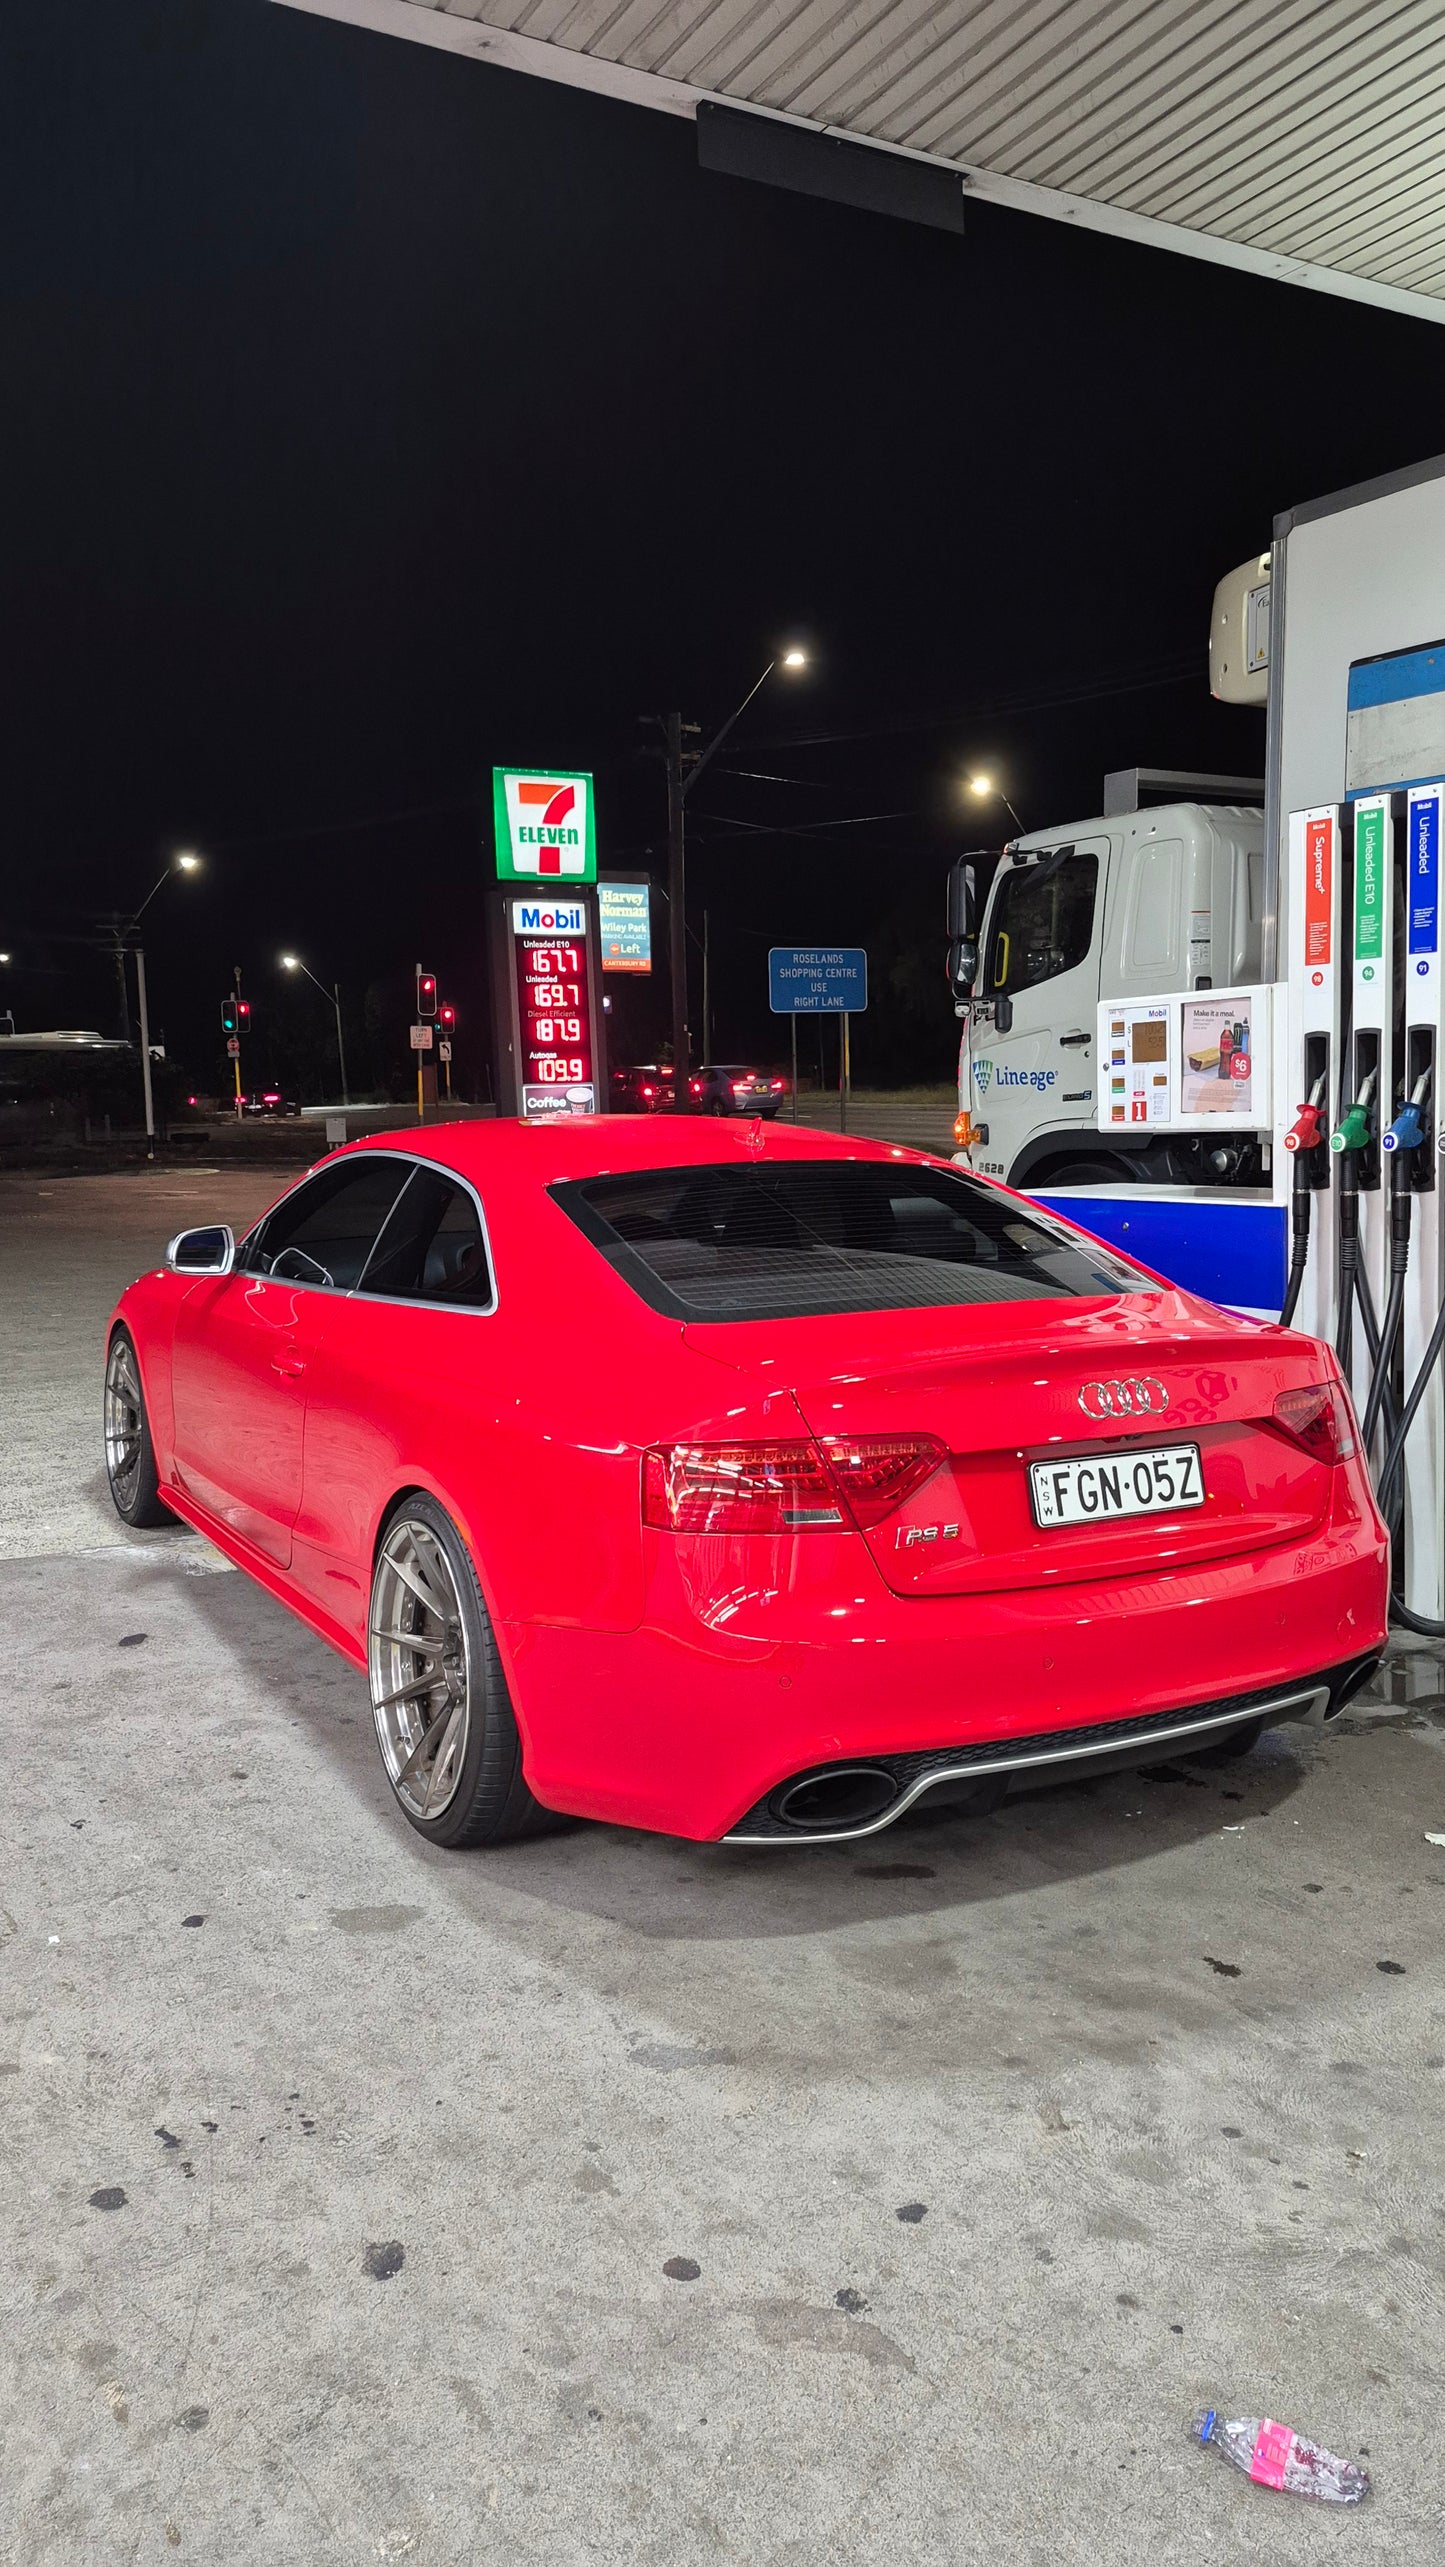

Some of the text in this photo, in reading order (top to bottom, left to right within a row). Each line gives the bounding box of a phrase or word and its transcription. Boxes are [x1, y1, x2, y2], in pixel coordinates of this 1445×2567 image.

[518, 782, 575, 874] 7
[1419, 816, 1430, 875] Unleaded
[1364, 826, 1376, 882] Unleaded
[601, 890, 644, 906] Harvey
[1364, 884, 1375, 905] E10
[600, 904, 647, 918] Norman
[521, 908, 580, 929] Mobil
[601, 921, 647, 933] Wiley Park
[523, 940, 570, 949] Unleaded E10
[620, 943, 641, 954] Left
[793, 953, 844, 964] ROSELANDS
[779, 968, 858, 979] SHOPPING CENTRE
[1418, 964, 1427, 972] 91
[525, 975, 558, 983] Unleaded
[810, 982, 828, 993] USE
[794, 996, 845, 1007] RIGHT LANE
[527, 1010, 576, 1018] Diesel Efficient
[1148, 1009, 1167, 1018] Mobil
[529, 1051, 557, 1061] Autogas
[538, 1059, 583, 1082] 109.9
[1234, 1058, 1247, 1072] $6
[996, 1066, 1055, 1091] Lineage
[527, 1096, 567, 1109] Coffee
[1135, 1103, 1143, 1120] 1
[1286, 1138, 1295, 1146] 98
[1384, 1138, 1393, 1146] 91
